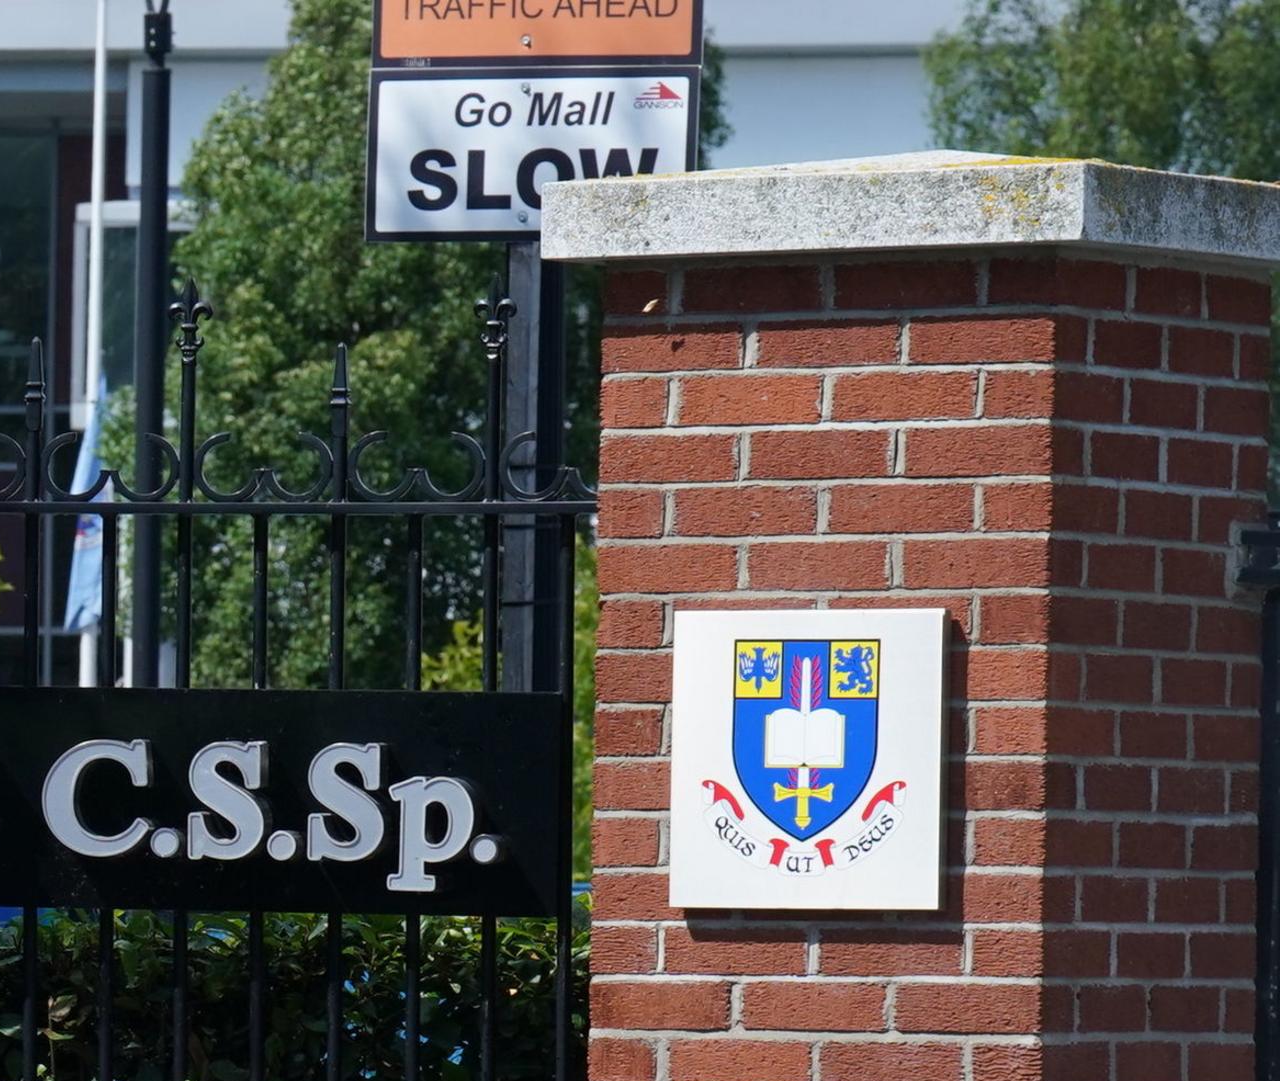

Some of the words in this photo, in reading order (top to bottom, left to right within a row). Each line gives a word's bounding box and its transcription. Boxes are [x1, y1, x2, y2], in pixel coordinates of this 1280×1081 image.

[454, 93, 513, 127] Go
[526, 92, 615, 127] Mall
[41, 738, 499, 893] C.S.Sp.
[714, 815, 757, 858] QUIS
[785, 857, 815, 873] UT
